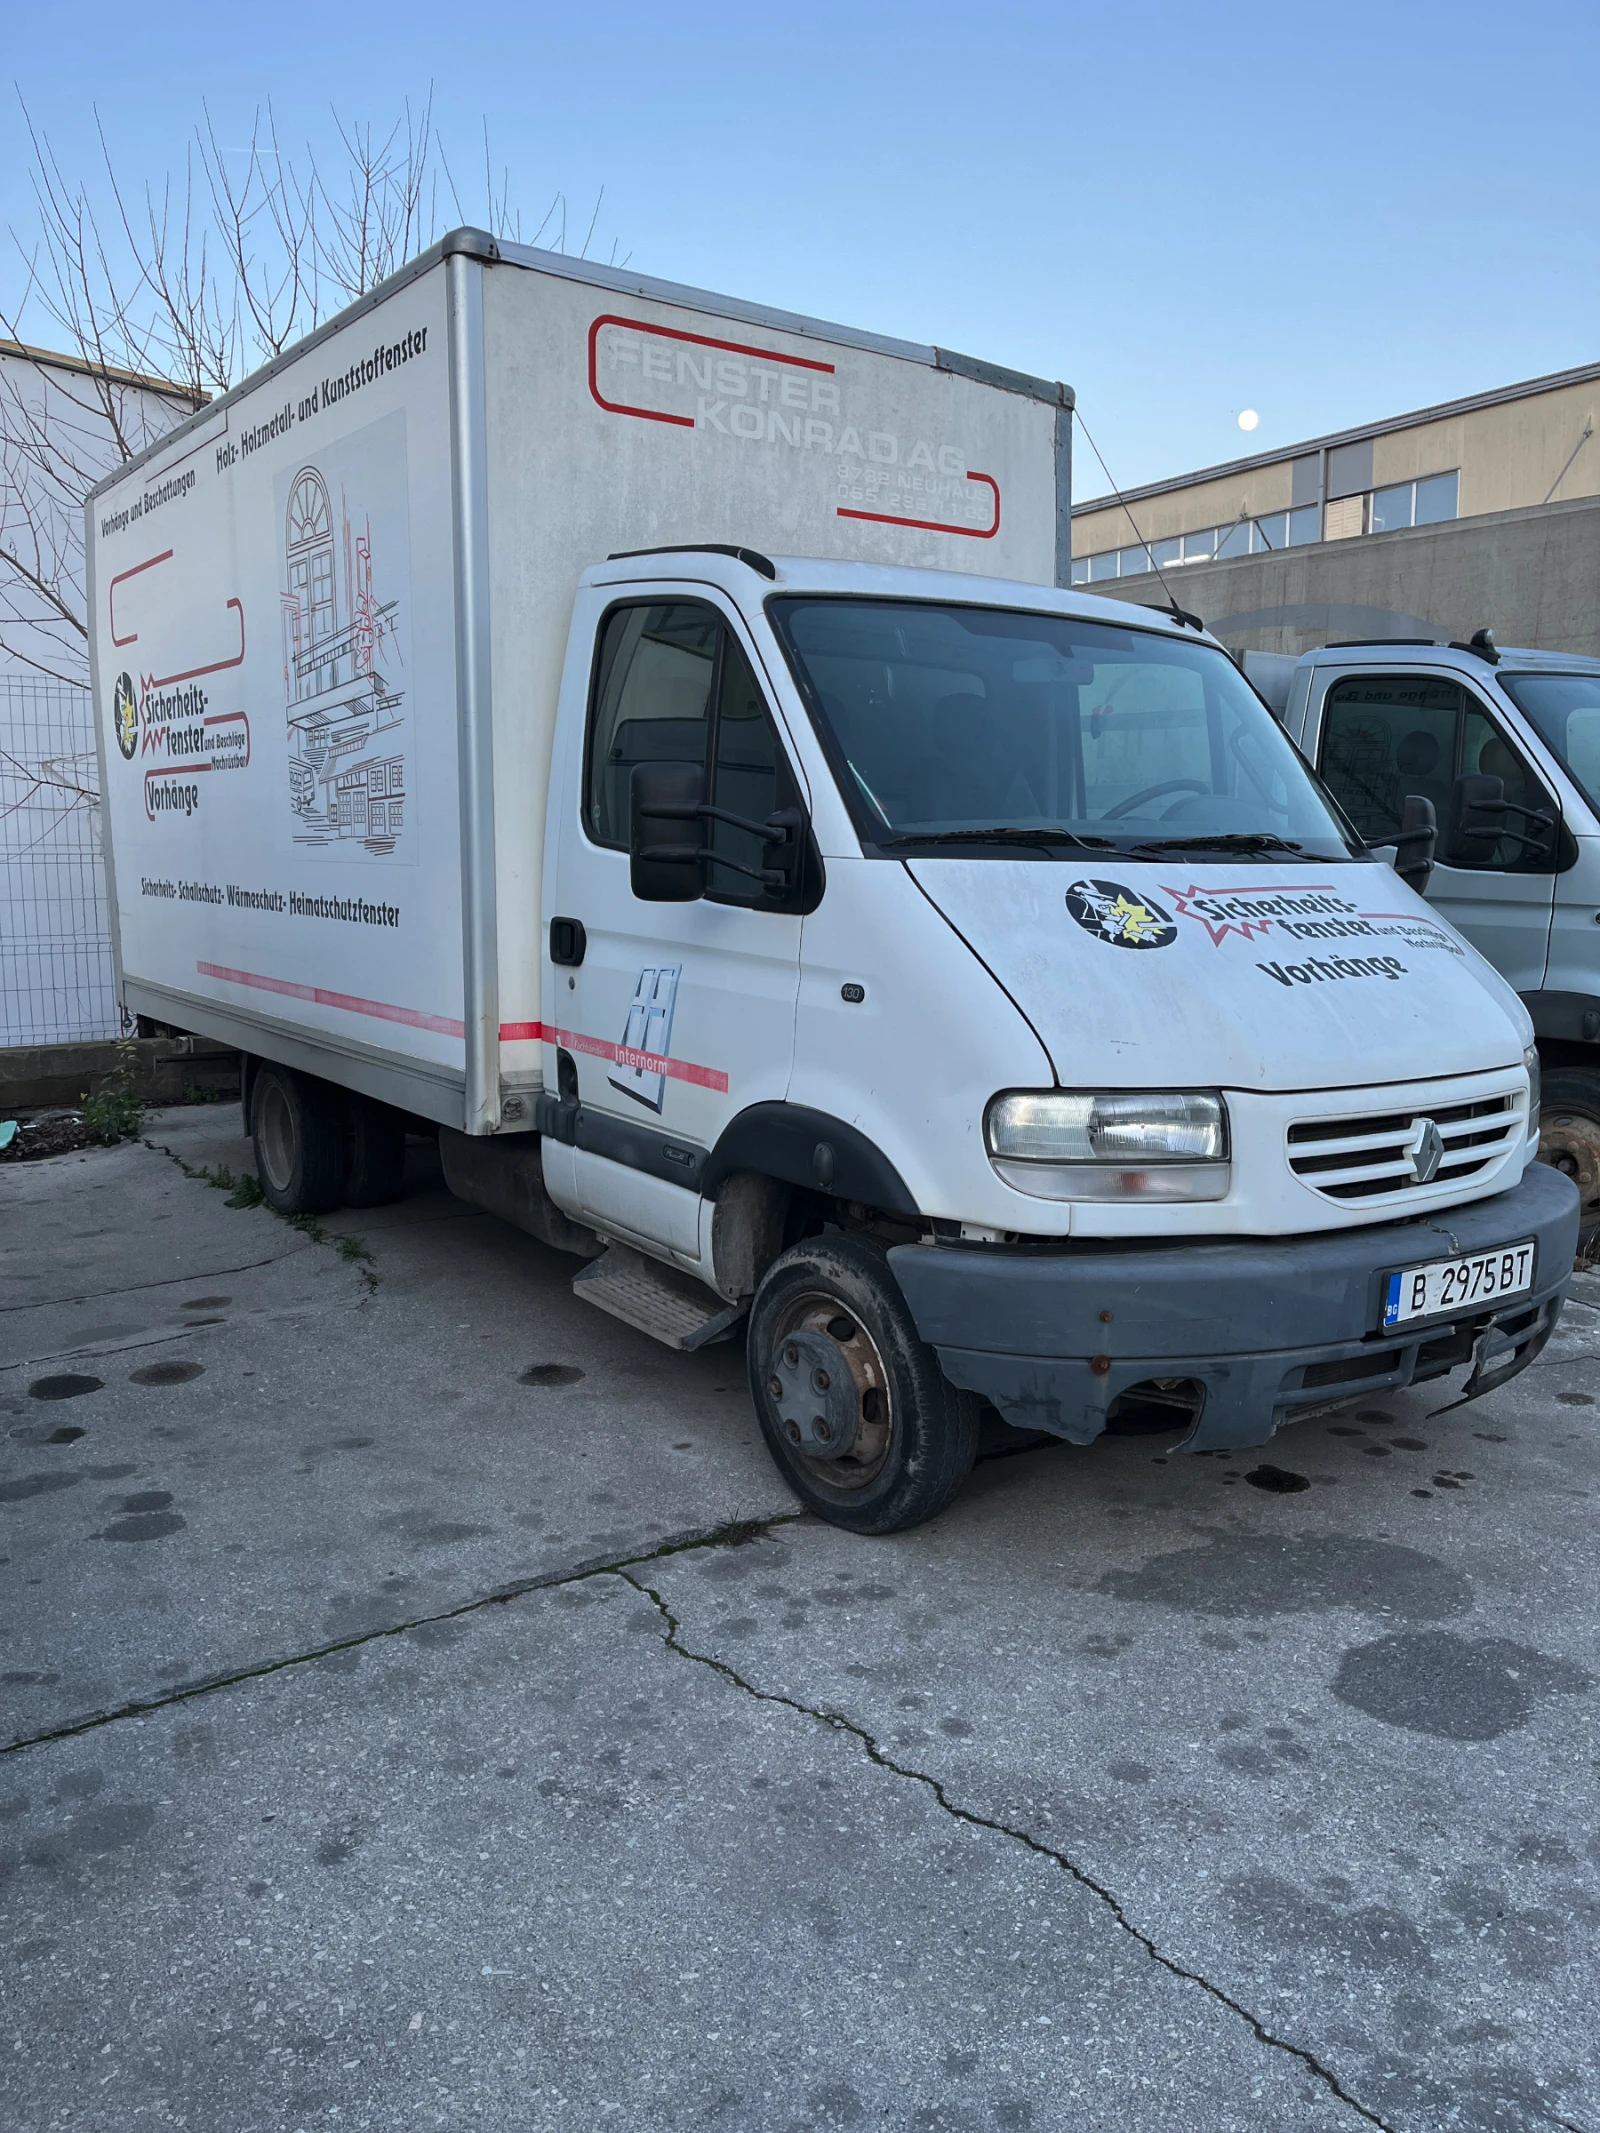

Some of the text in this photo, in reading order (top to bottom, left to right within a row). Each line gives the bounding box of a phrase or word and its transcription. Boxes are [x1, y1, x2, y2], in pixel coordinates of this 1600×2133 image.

[608, 335, 841, 416] FENSTER
[215, 325, 429, 475] Holz- Holzmetall- und Kunststoffenster
[696, 396, 965, 477] KONRAD AG
[101, 469, 196, 538] Vorhänge und Beschattungen
[897, 472, 989, 503] NEUHAUS
[145, 684, 209, 724] Sicherheits-
[204, 734, 215, 751] und
[147, 779, 198, 817] Vorhänge
[141, 877, 400, 928] Sicherheits- Schallschutz- Wärmeschutz- Heimatschutzfenster
[1193, 894, 1359, 922] Sicherheits-
[1255, 954, 1409, 987] Vorhänge
[842, 986, 860, 999] 130
[615, 1045, 668, 1074] Internorm
[1387, 1304, 1398, 1317] BG
